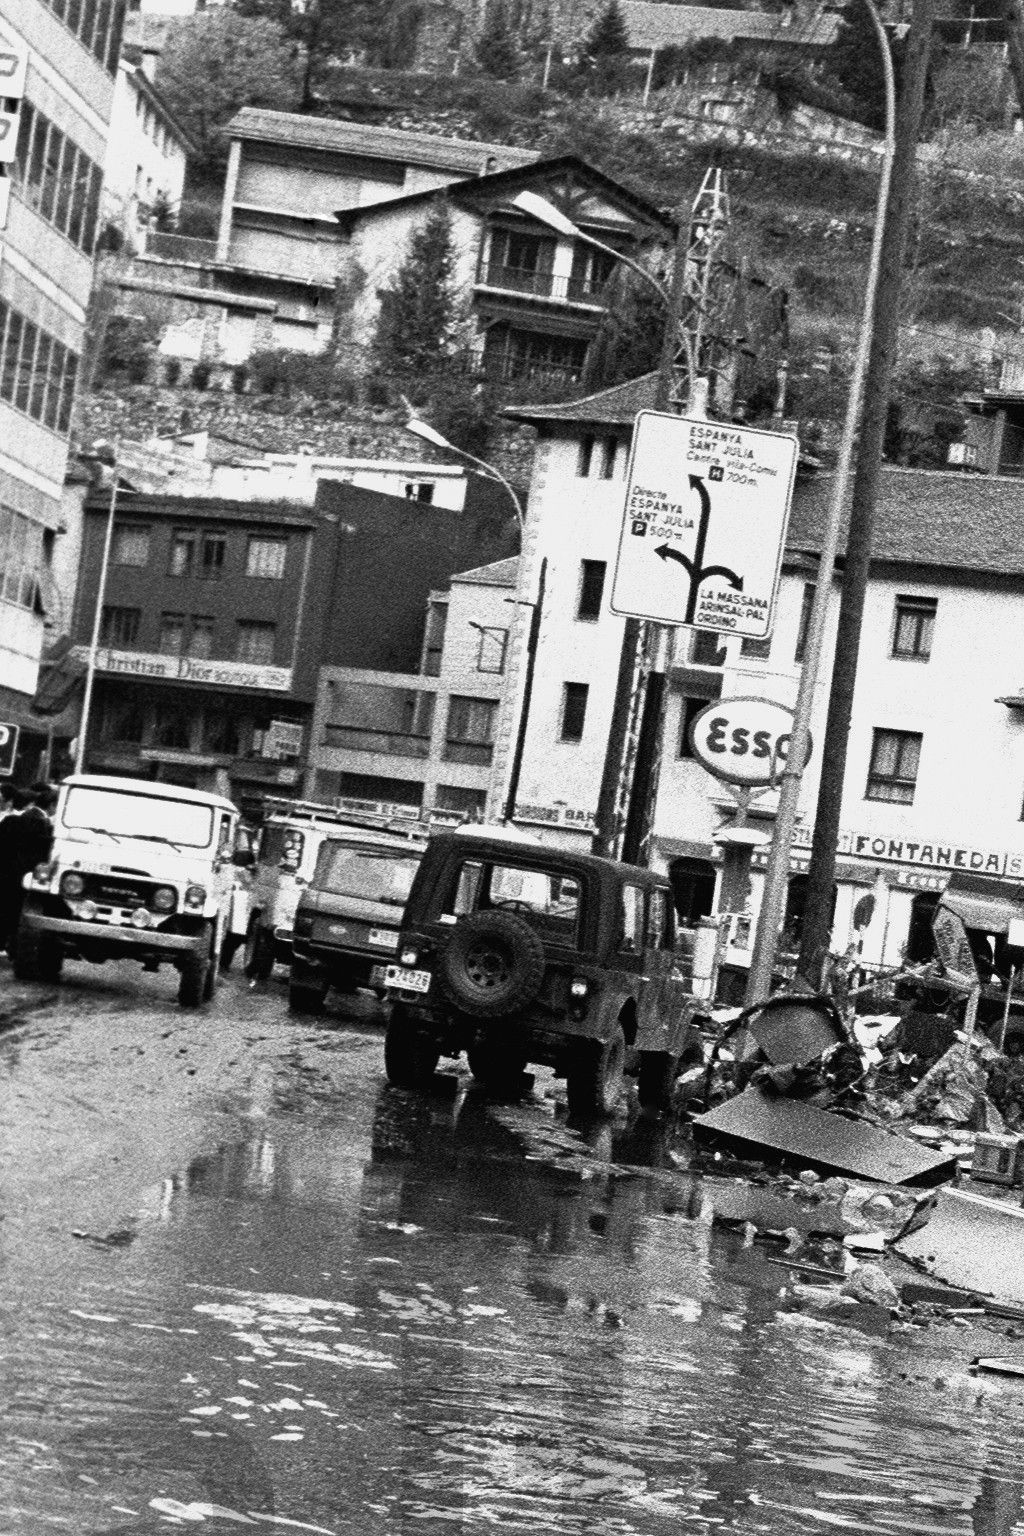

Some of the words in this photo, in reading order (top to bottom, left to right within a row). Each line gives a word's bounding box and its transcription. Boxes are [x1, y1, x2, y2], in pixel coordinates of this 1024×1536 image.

[690, 426, 742, 444] ESPANYA
[689, 439, 717, 452] SANT
[630, 497, 682, 514] ESPANYA
[629, 509, 657, 522] SANT
[701, 589, 713, 600] LA
[718, 592, 768, 608] MASSANA
[698, 612, 737, 628] ORDINO
[856, 836, 1000, 872] FONTANEDA
